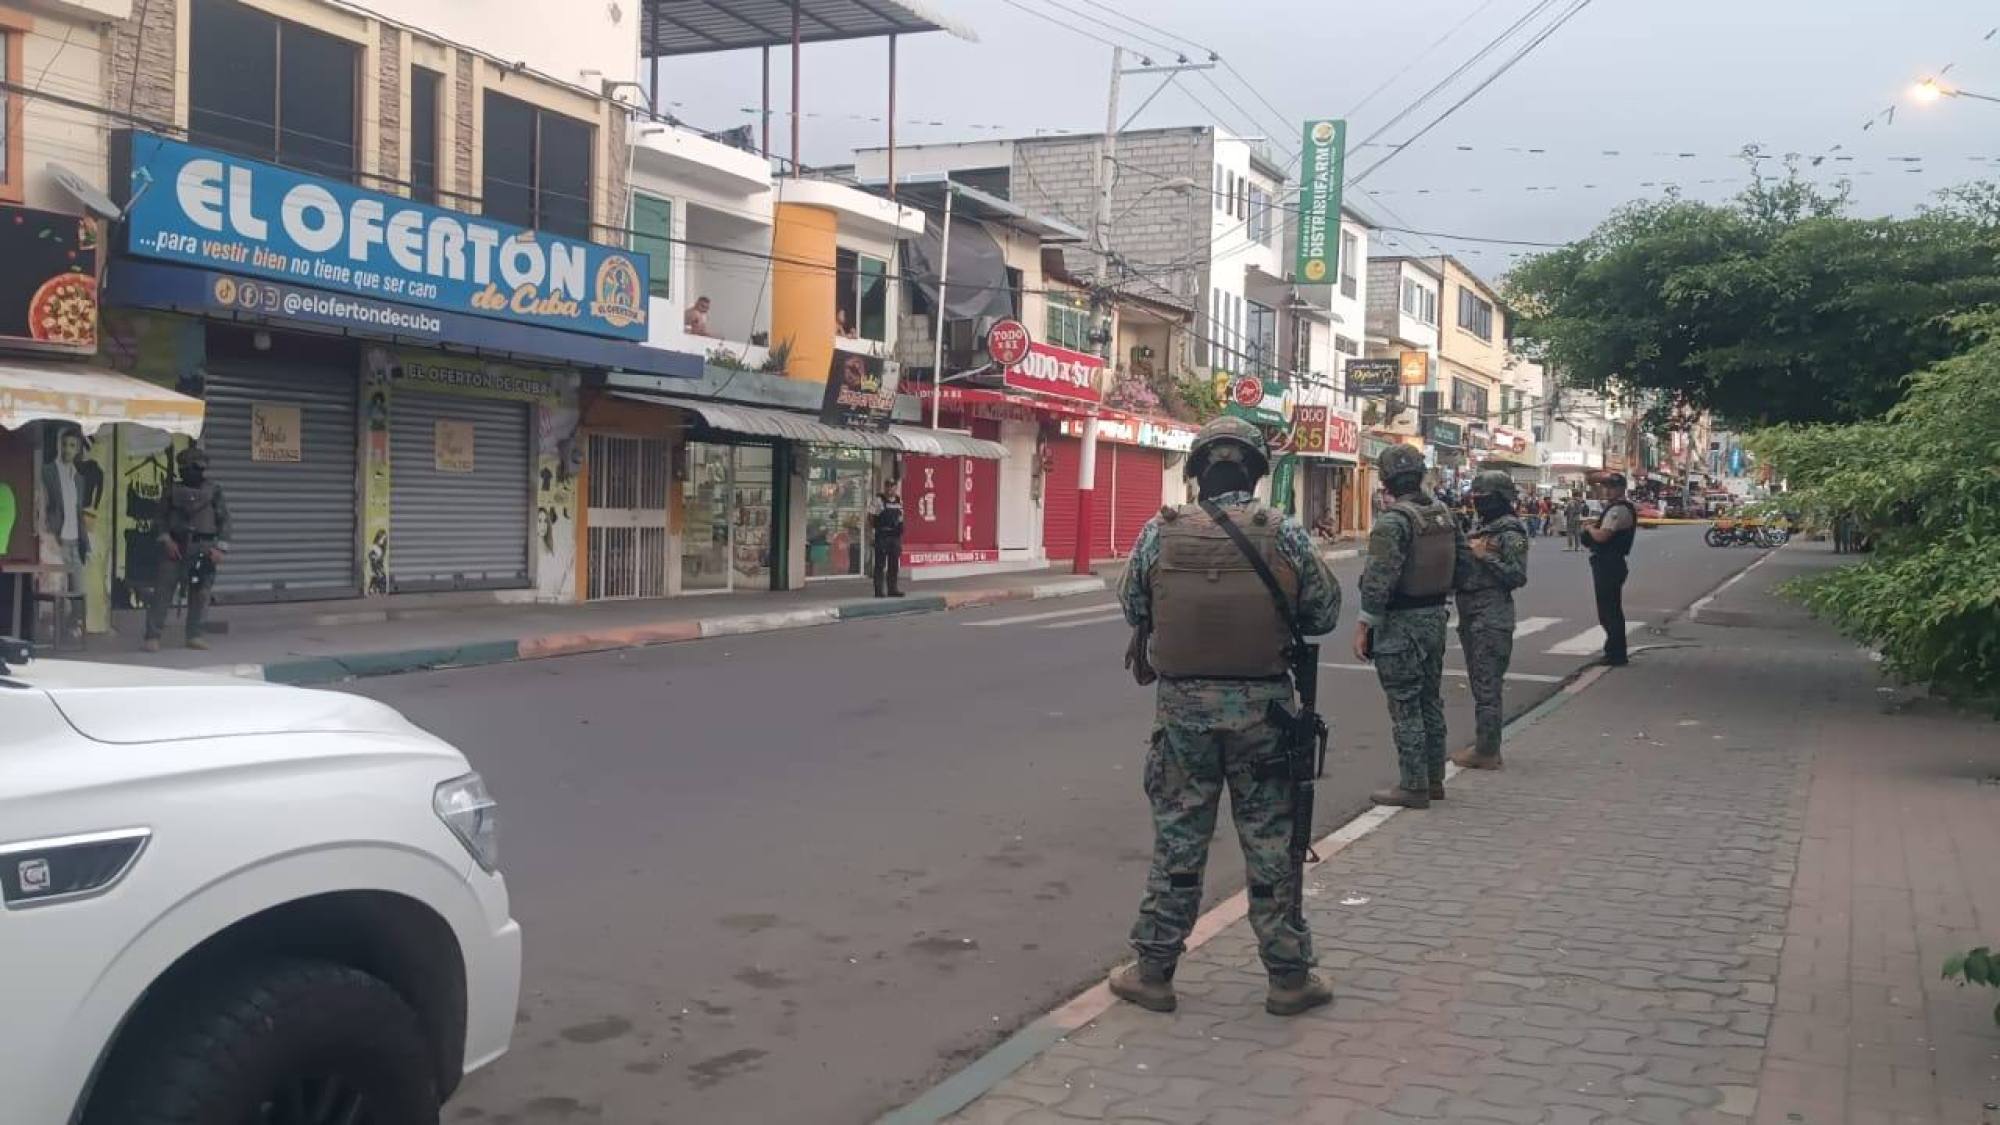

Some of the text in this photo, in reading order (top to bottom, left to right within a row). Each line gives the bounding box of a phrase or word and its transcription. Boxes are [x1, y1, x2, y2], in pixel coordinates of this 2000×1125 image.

[176, 158, 268, 241] EL
[202, 239, 249, 264] vestir
[252, 245, 287, 271] bien
[290, 257, 310, 276] no
[313, 256, 351, 283] tiene
[354, 271, 380, 291] que
[383, 275, 405, 294] ser
[407, 281, 438, 300] caro
[283, 292, 441, 332] @elofertondecuba
[471, 282, 582, 318] de Cuba
[993, 330, 1023, 341] TODO
[1295, 426, 1323, 450] $5
